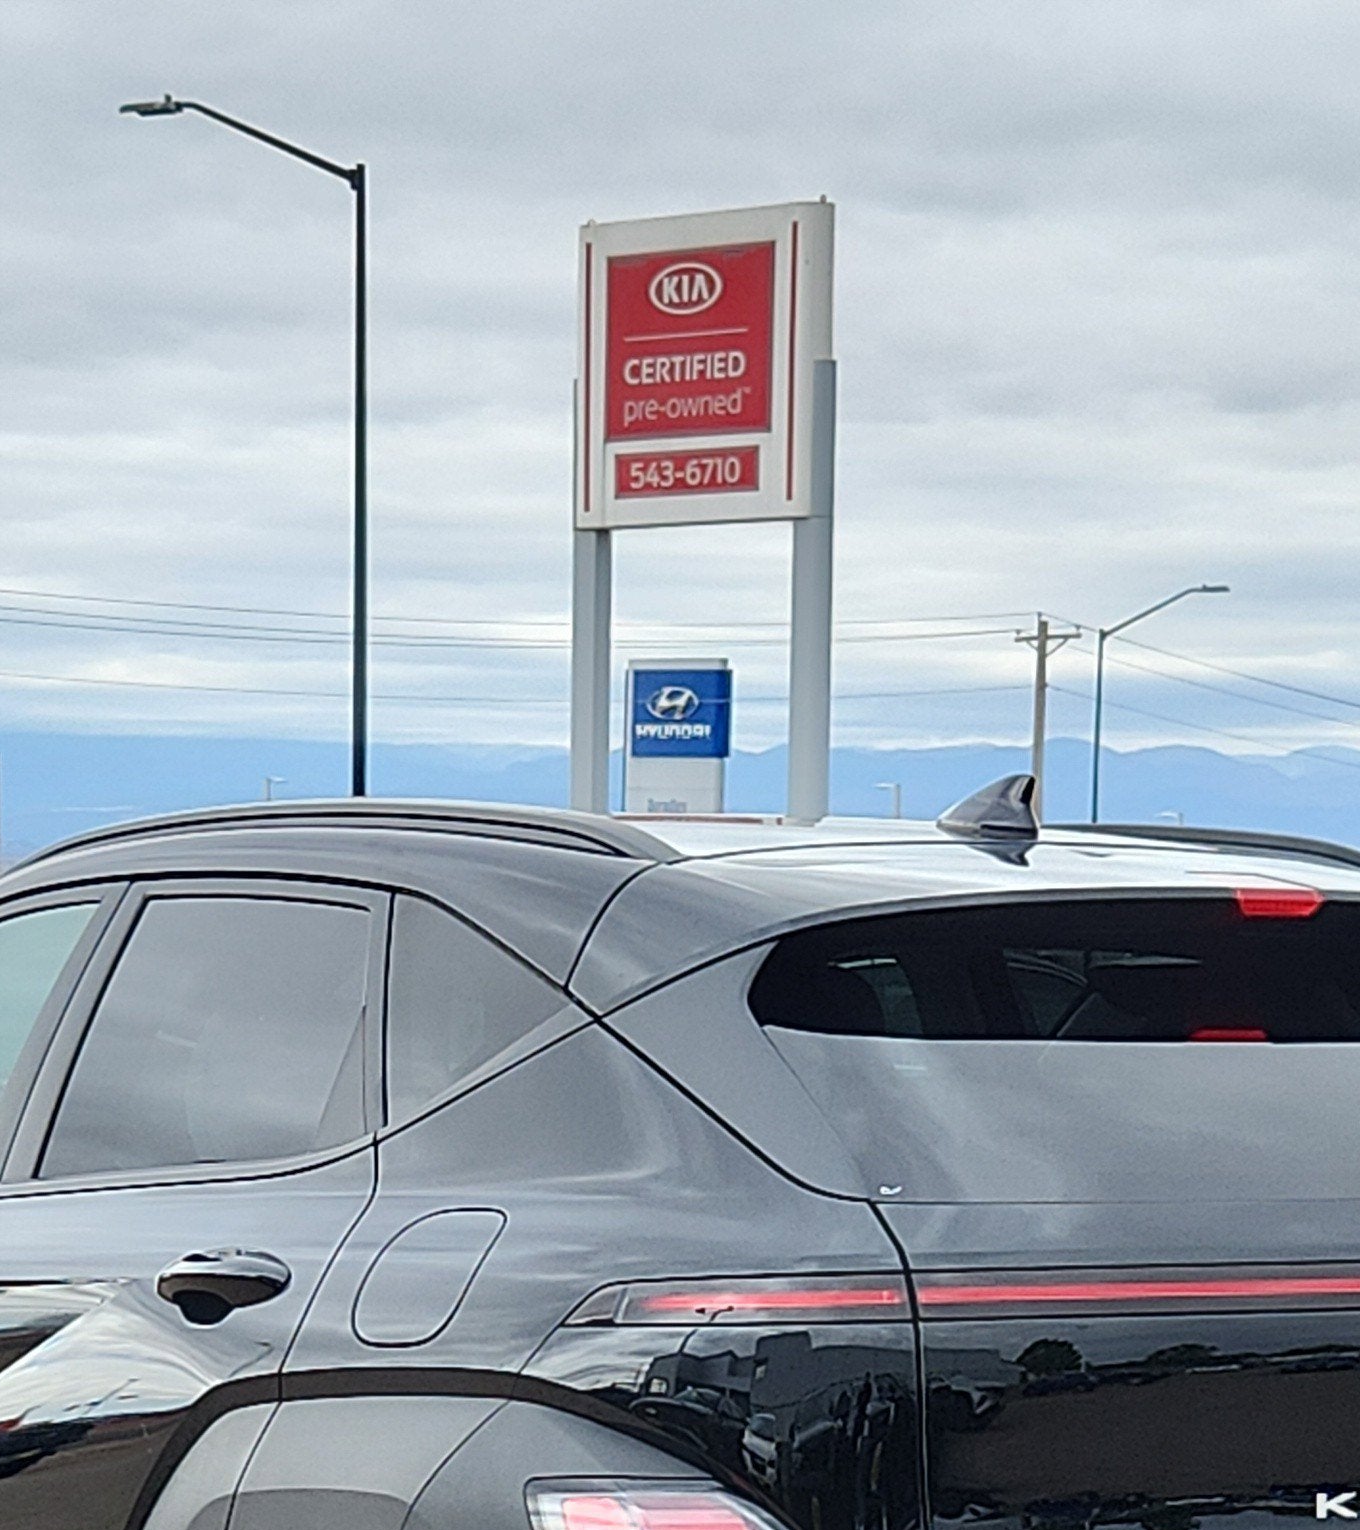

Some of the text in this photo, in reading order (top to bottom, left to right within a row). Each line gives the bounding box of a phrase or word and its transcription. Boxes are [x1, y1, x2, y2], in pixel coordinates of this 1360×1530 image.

[662, 275, 709, 304] KIA
[623, 351, 746, 385] CERTIFIED
[623, 391, 743, 427] pre-owned
[629, 456, 741, 489] 543-6710
[635, 724, 711, 738] HYUNDAI
